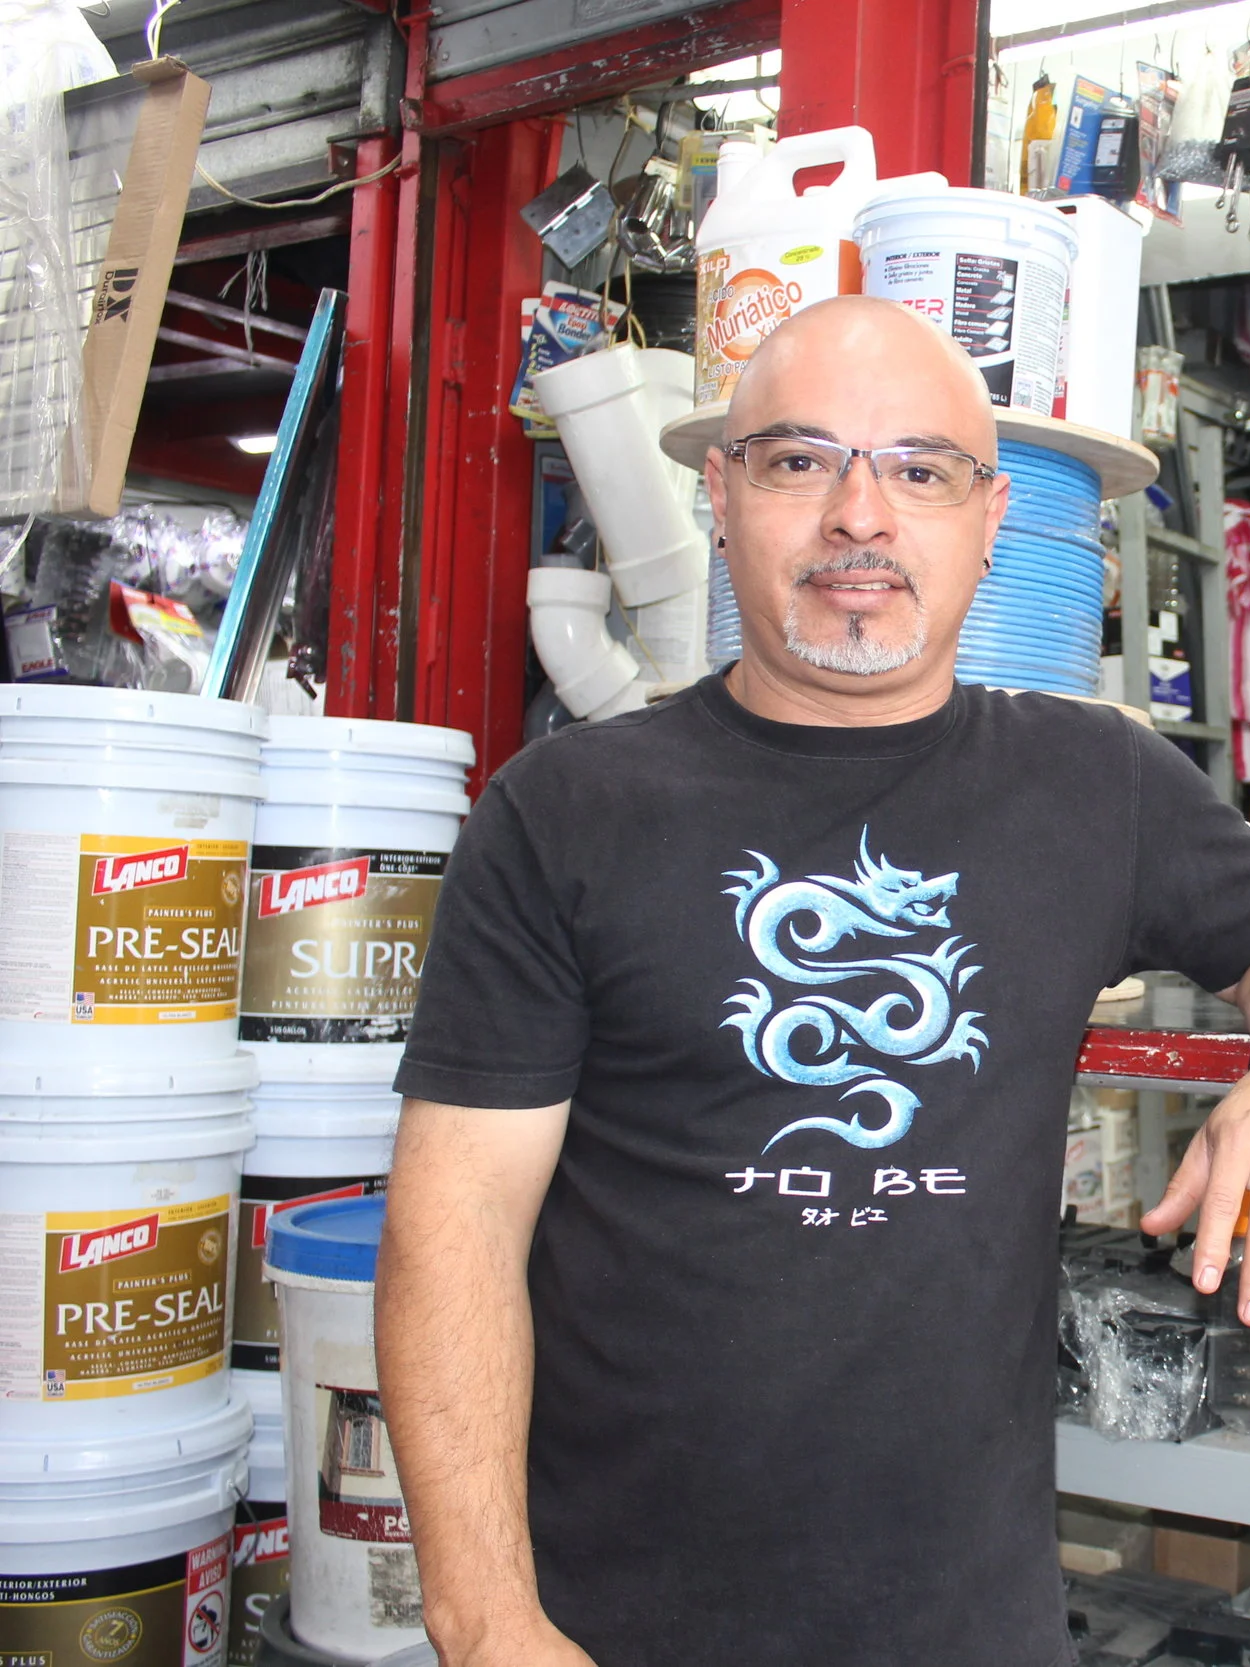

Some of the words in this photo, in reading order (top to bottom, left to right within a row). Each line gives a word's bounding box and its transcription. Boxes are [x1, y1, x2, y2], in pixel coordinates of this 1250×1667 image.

[706, 281, 803, 354] Muriático
[557, 323, 593, 341] Bonder
[102, 854, 181, 892] LANCO
[270, 868, 359, 914] LANCO
[196, 908, 213, 918] PLUS
[396, 919, 420, 929] PLUS
[87, 926, 240, 960] PRE-SEAL
[76, 1006, 93, 1014] USA
[873, 1165, 966, 1197] BE
[70, 1224, 150, 1268] LANCO
[118, 1277, 165, 1289] PAINTER'S
[169, 1274, 188, 1283] PLUS
[57, 1282, 223, 1335] PRE-SEAL
[47, 1383, 64, 1392] USA
[234, 1527, 289, 1568] ANC
[110, 1619, 124, 1636] 7
[11, 1656, 46, 1666] PLUS
